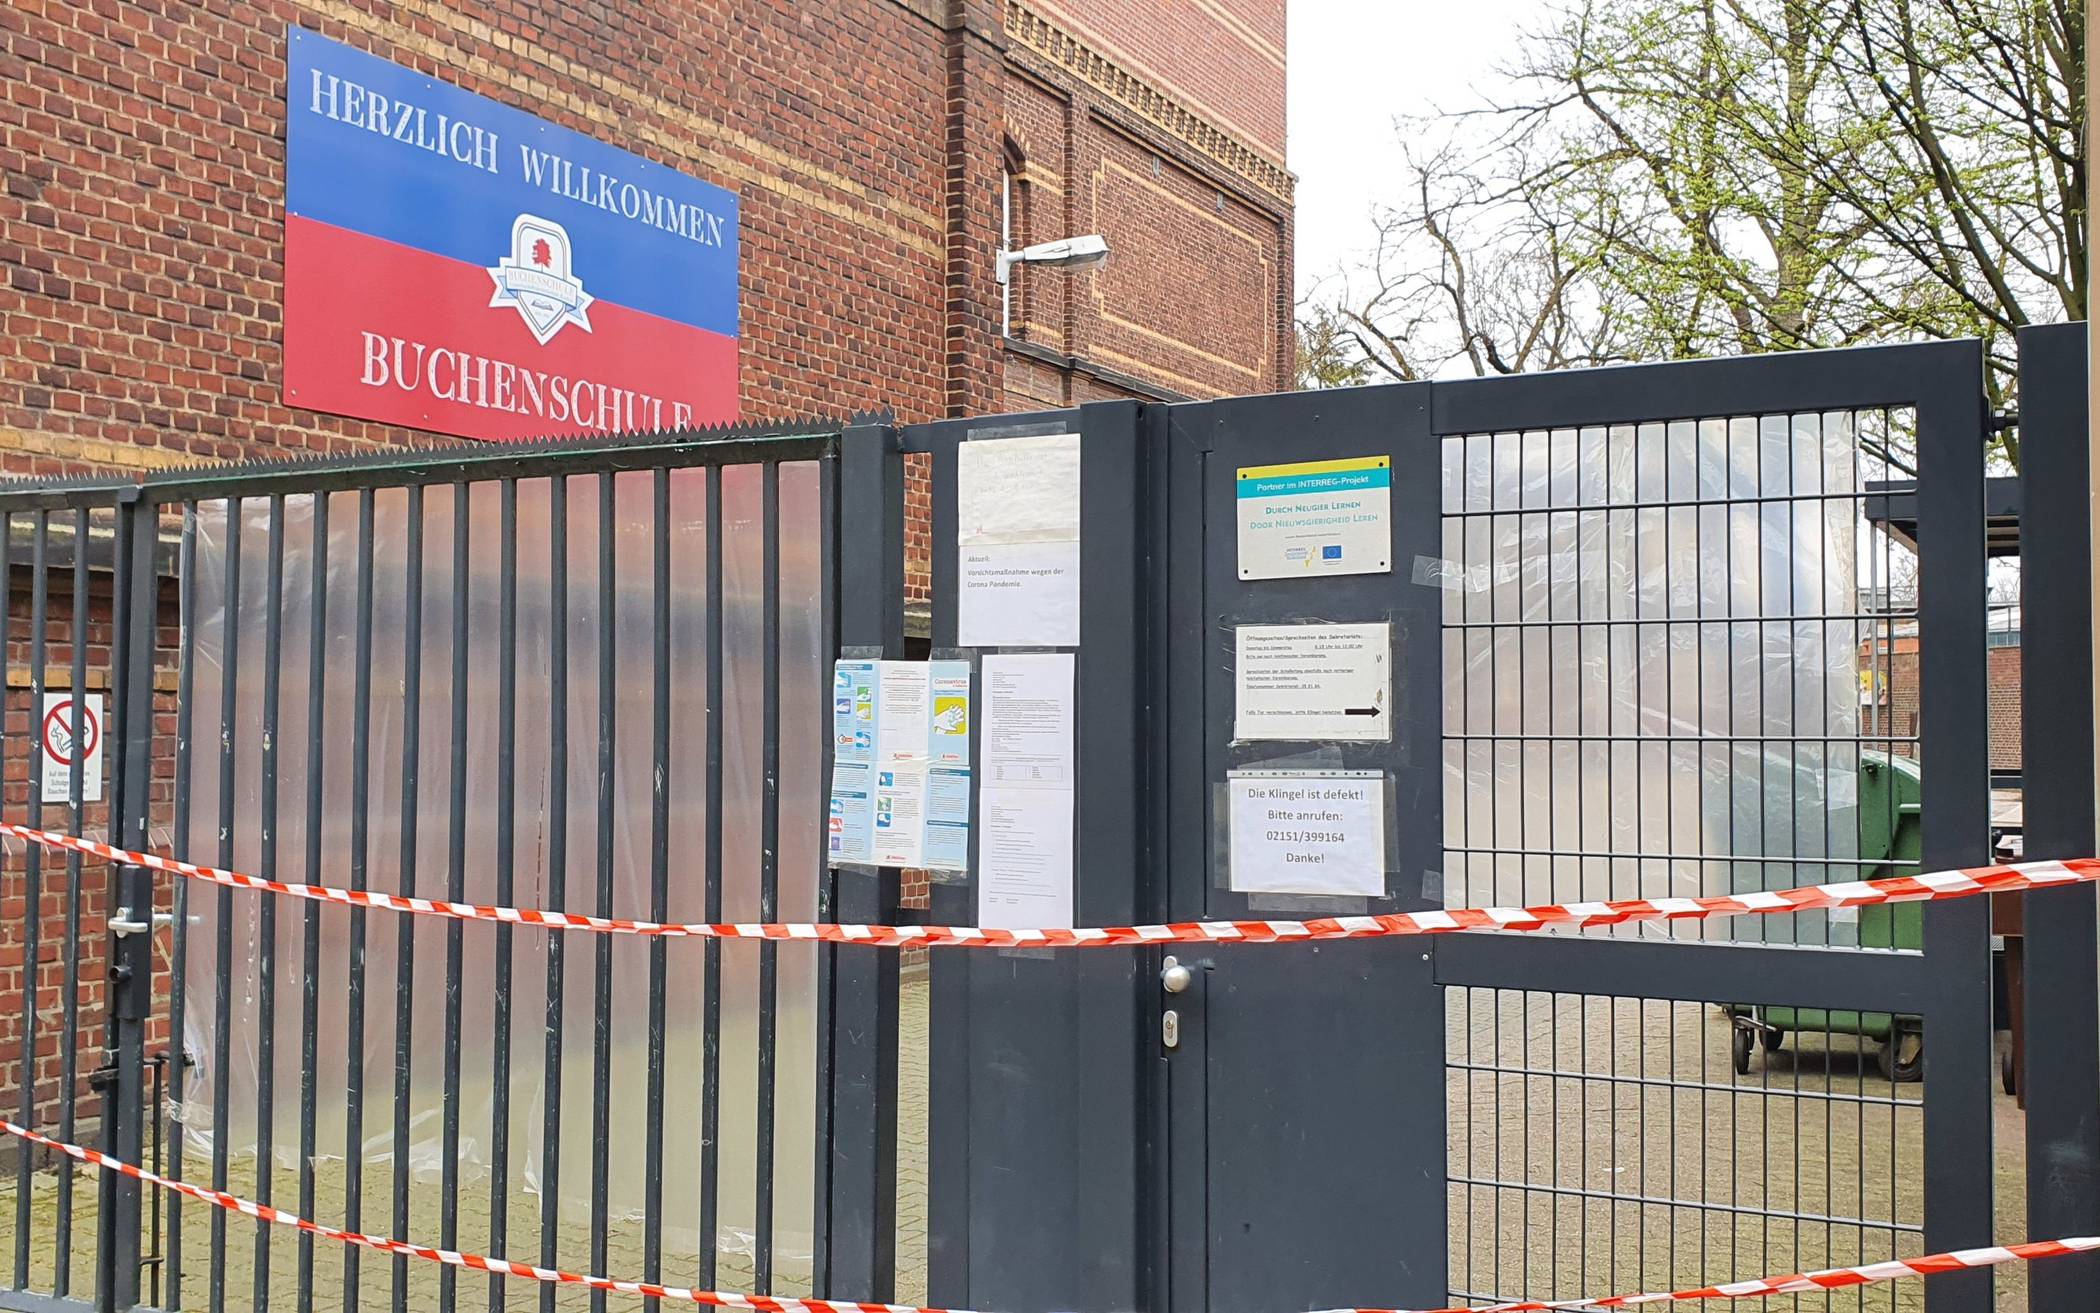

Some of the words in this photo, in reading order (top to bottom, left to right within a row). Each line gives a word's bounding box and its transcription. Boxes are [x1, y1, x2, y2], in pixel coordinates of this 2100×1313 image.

[310, 68, 498, 174] HERZLICH
[520, 144, 725, 248] WILLKOMMEN
[360, 331, 692, 435] BUCHENSCHULE
[1257, 482, 1285, 492] Partner
[1287, 480, 1296, 489] im
[1298, 476, 1369, 488] INTERREG-Projekt
[1031, 569, 1052, 577] wegen
[1248, 788, 1265, 798] Die
[1268, 788, 1305, 801] Klingel
[1307, 788, 1321, 799] ist
[1323, 789, 1364, 800] defekt!
[1268, 809, 1293, 820] Bitte
[1296, 810, 1343, 821] anrufen:
[1266, 831, 1345, 843] 02151/399164
[1286, 852, 1325, 863] Danke!
